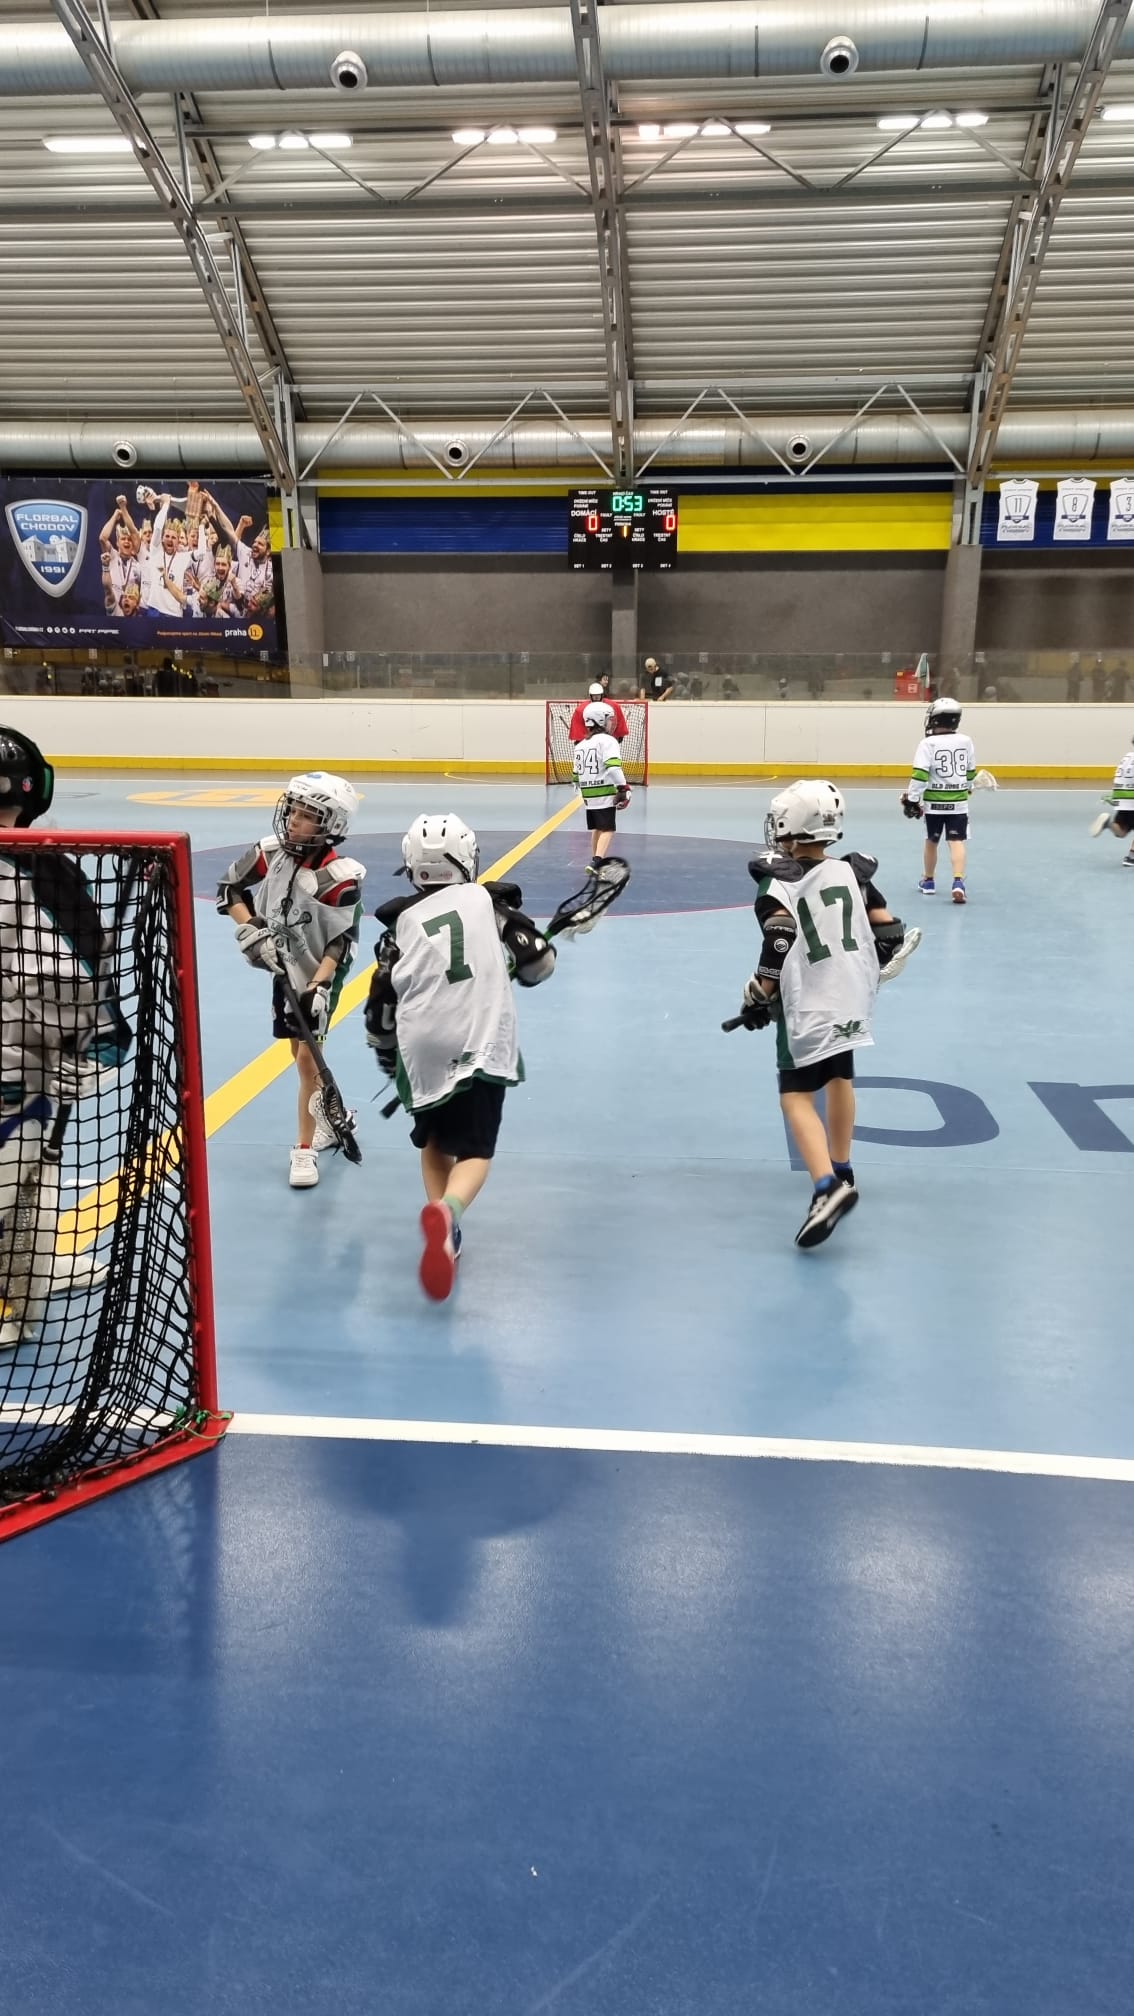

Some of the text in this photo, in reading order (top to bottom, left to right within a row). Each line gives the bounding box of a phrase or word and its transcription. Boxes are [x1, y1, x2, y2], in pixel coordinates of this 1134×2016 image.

[613, 496, 643, 512] 0:53
[1072, 496, 1078, 512] 8
[1126, 496, 1132, 512] 3
[16, 513, 78, 523] FLORBAL
[589, 516, 598, 531] 0
[666, 515, 676, 531] 0
[21, 523, 75, 531] CHODOV
[41, 565, 66, 574] 1991
[225, 629, 247, 638] praha
[935, 748, 969, 778] 38
[796, 886, 859, 964] 17
[422, 910, 474, 985] 7
